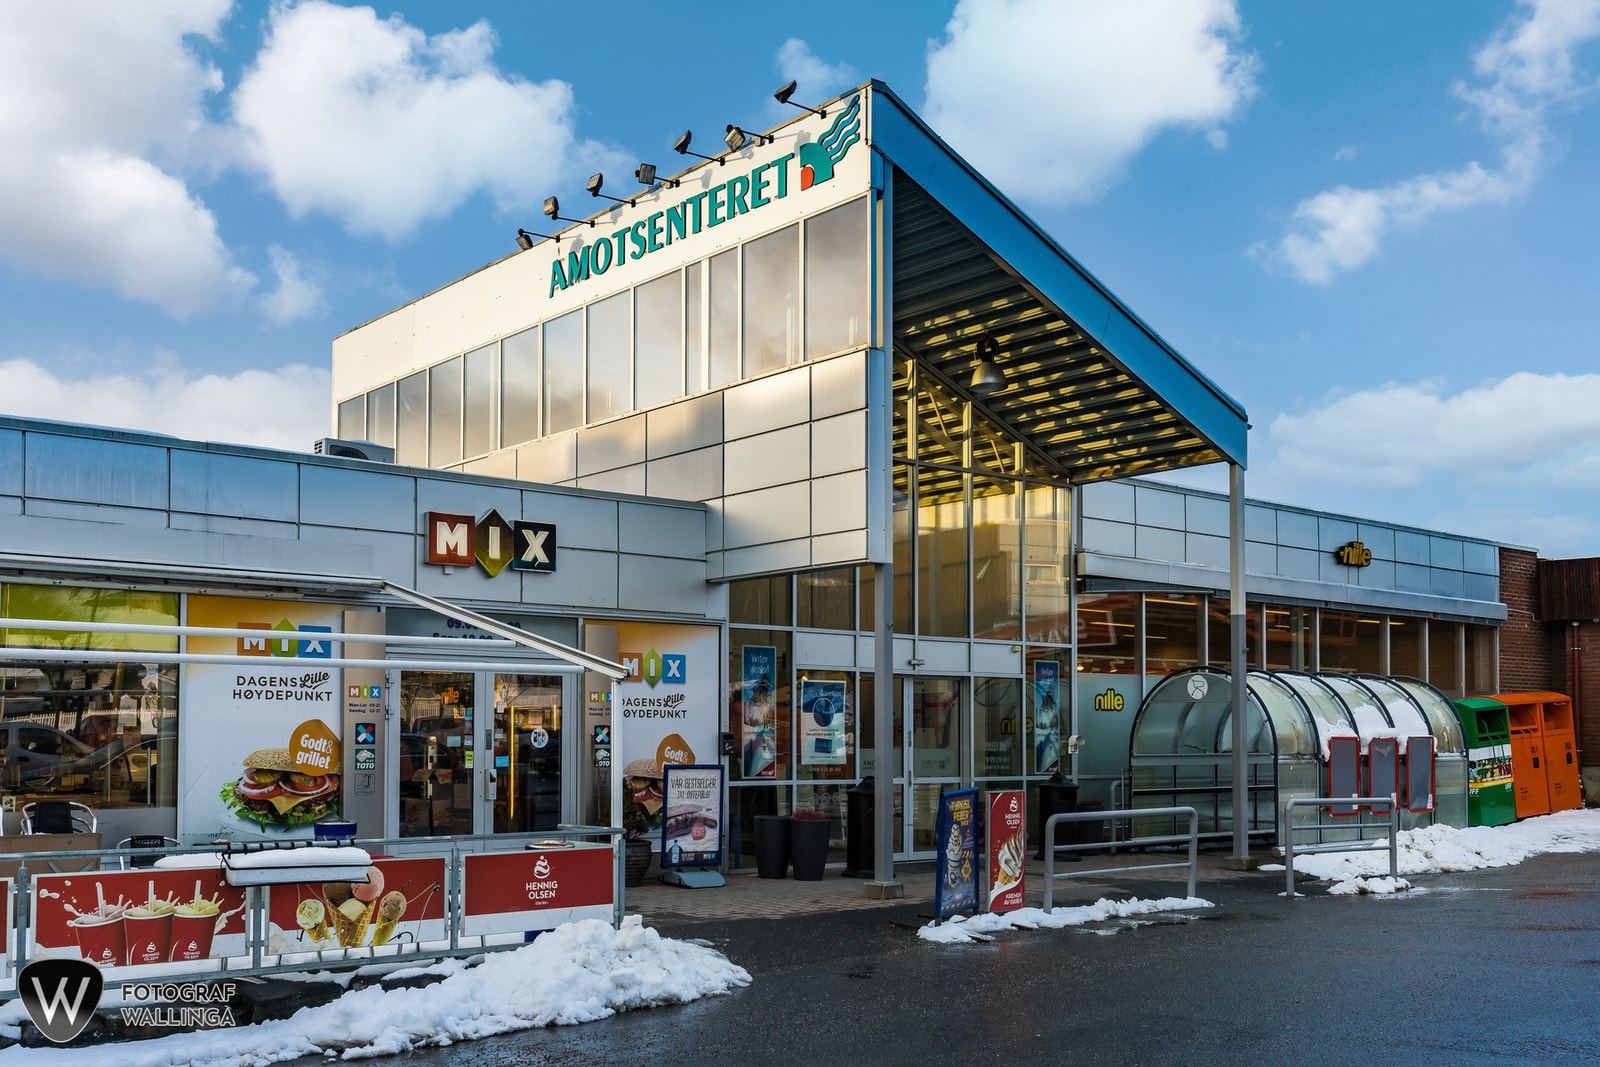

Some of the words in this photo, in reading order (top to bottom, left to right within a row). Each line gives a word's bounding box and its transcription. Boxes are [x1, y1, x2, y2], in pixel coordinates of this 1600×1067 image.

[436, 520, 550, 564] MIX
[1343, 542, 1371, 566] nille
[622, 657, 681, 678] MIX
[236, 675, 298, 688] DAGENS
[299, 671, 331, 690] Lille
[233, 689, 333, 702] HØYDEPUNKT
[350, 687, 380, 697] MIX
[1095, 689, 1124, 711] nille
[662, 693, 686, 709] Lille
[623, 709, 688, 719] ØYDEPUNKT
[296, 751, 331, 769] grillet
[525, 880, 558, 890] HENNIG
[528, 890, 556, 899] OLSEN
